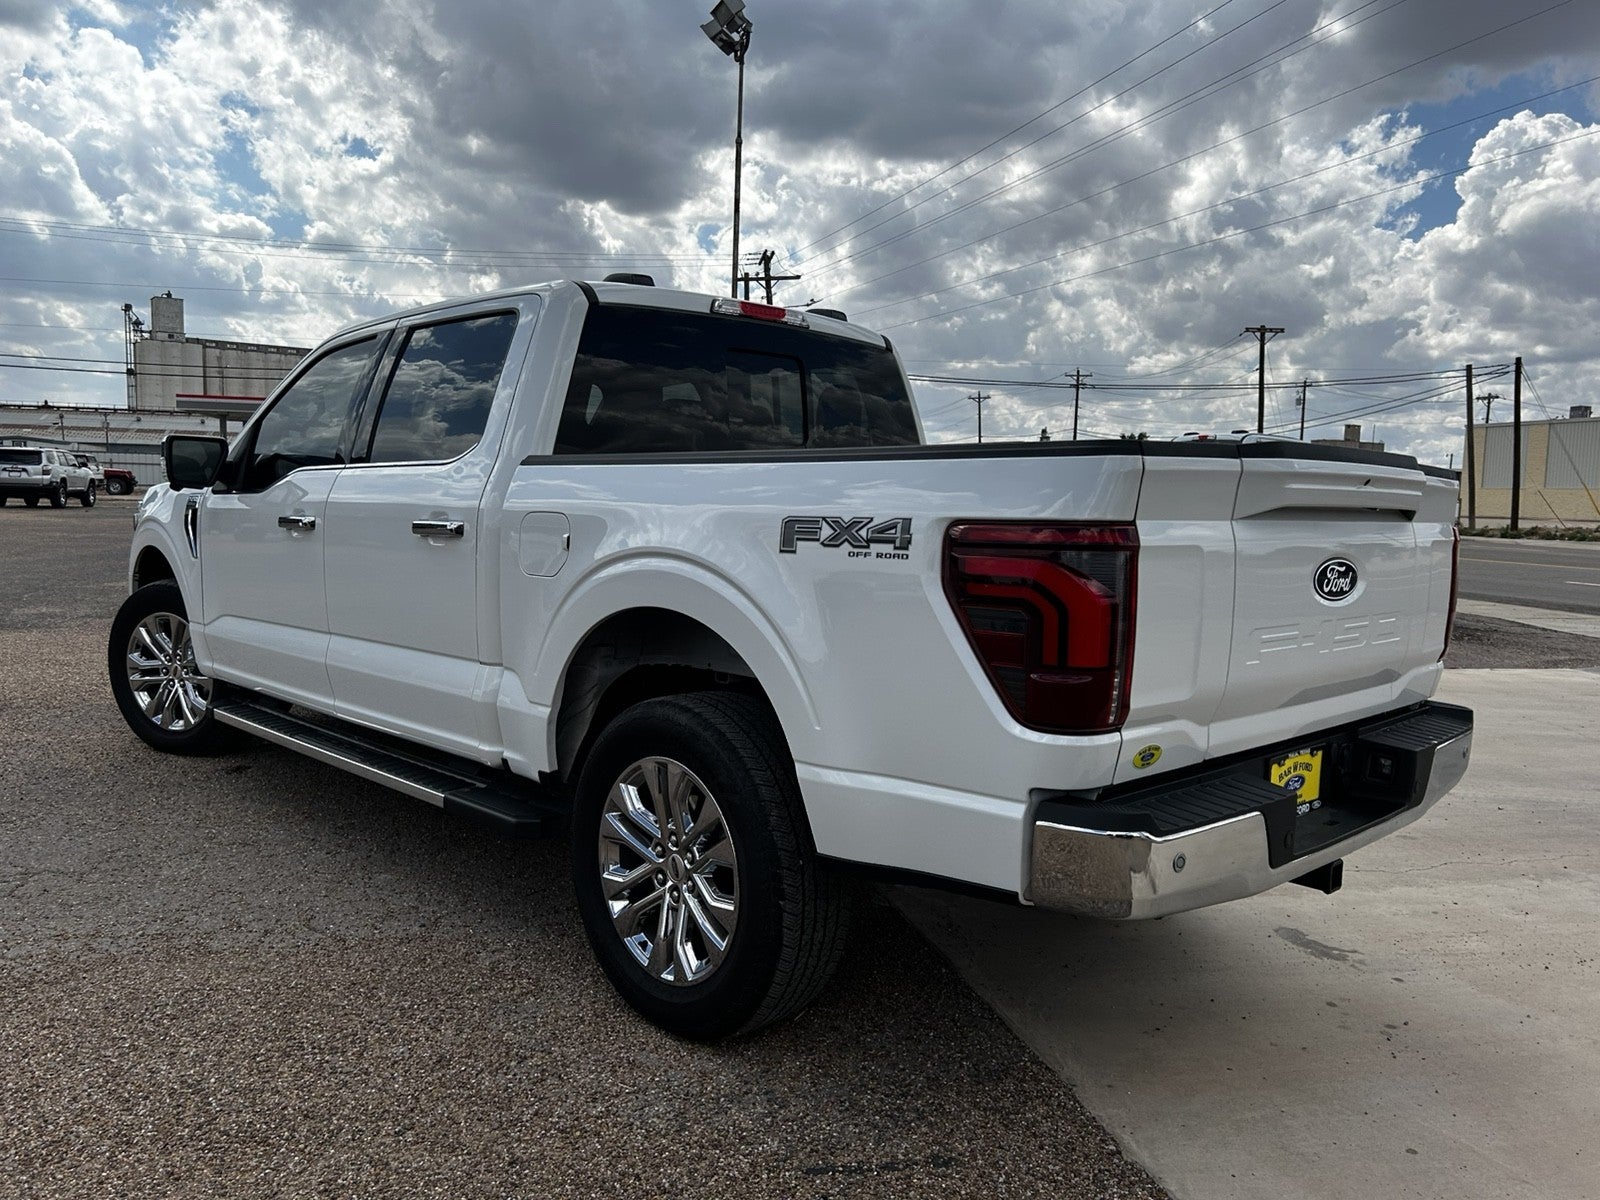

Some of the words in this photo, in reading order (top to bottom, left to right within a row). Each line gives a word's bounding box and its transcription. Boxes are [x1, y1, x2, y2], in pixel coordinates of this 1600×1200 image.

[779, 516, 913, 553] FX4
[876, 552, 909, 560] ROAD
[1323, 565, 1352, 593] Ford
[1279, 766, 1292, 783] BAR
[1299, 762, 1313, 772] FORD
